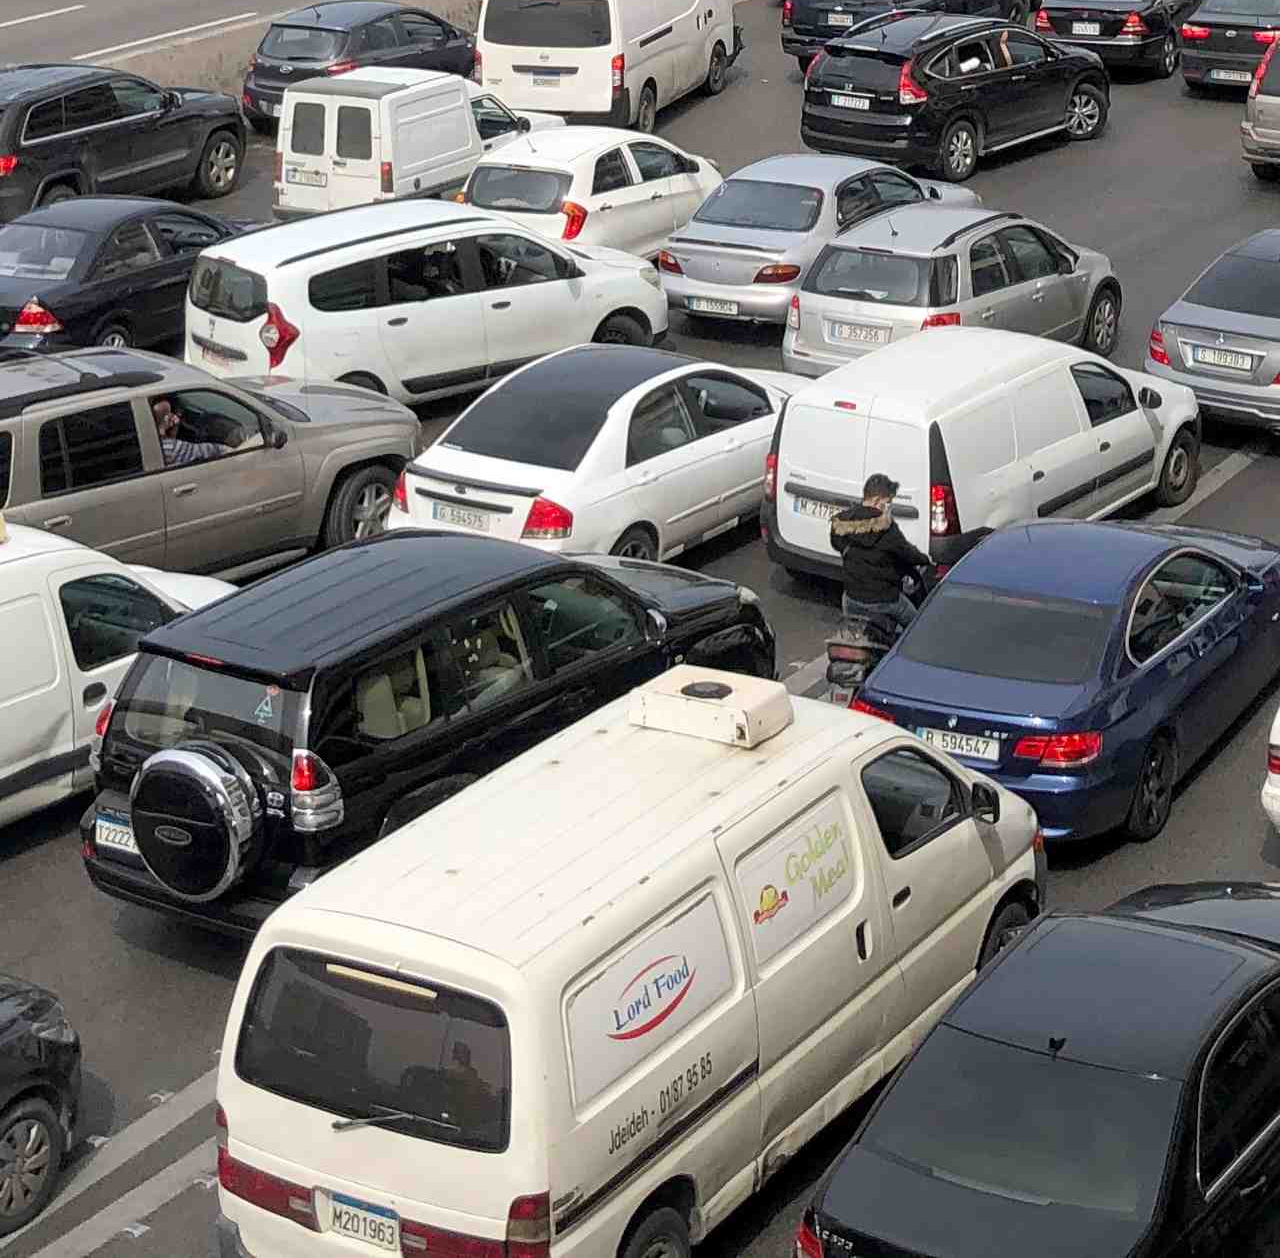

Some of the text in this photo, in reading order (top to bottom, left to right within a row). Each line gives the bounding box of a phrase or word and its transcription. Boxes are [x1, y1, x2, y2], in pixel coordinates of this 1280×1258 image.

[941, 733, 991, 756] 594547
[785, 821, 842, 883] Golden
[613, 955, 690, 1031] Lord Food
[608, 1110, 649, 1155] Jdeideh
[686, 1069, 699, 1091] 95
[700, 1051, 713, 1082] 85
[332, 1205, 395, 1245] M201963
